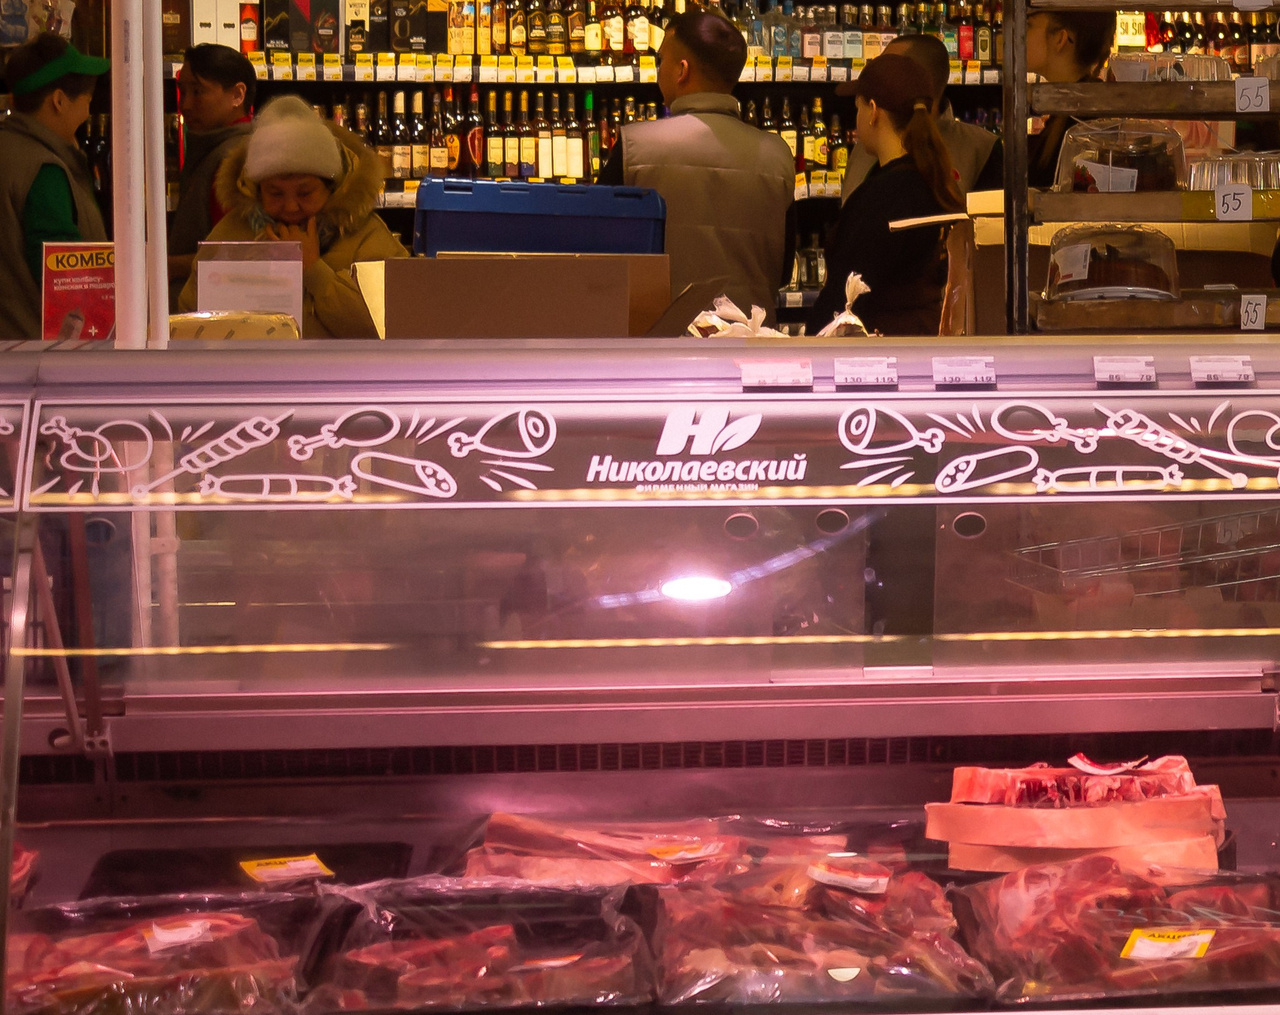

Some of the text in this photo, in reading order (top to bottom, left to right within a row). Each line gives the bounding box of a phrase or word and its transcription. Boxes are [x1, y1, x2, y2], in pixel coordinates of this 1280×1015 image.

[1238, 85, 1268, 111] 55
[1221, 192, 1245, 214] 55
[1243, 301, 1262, 327] 55
[586, 453, 808, 483] Николаевский
